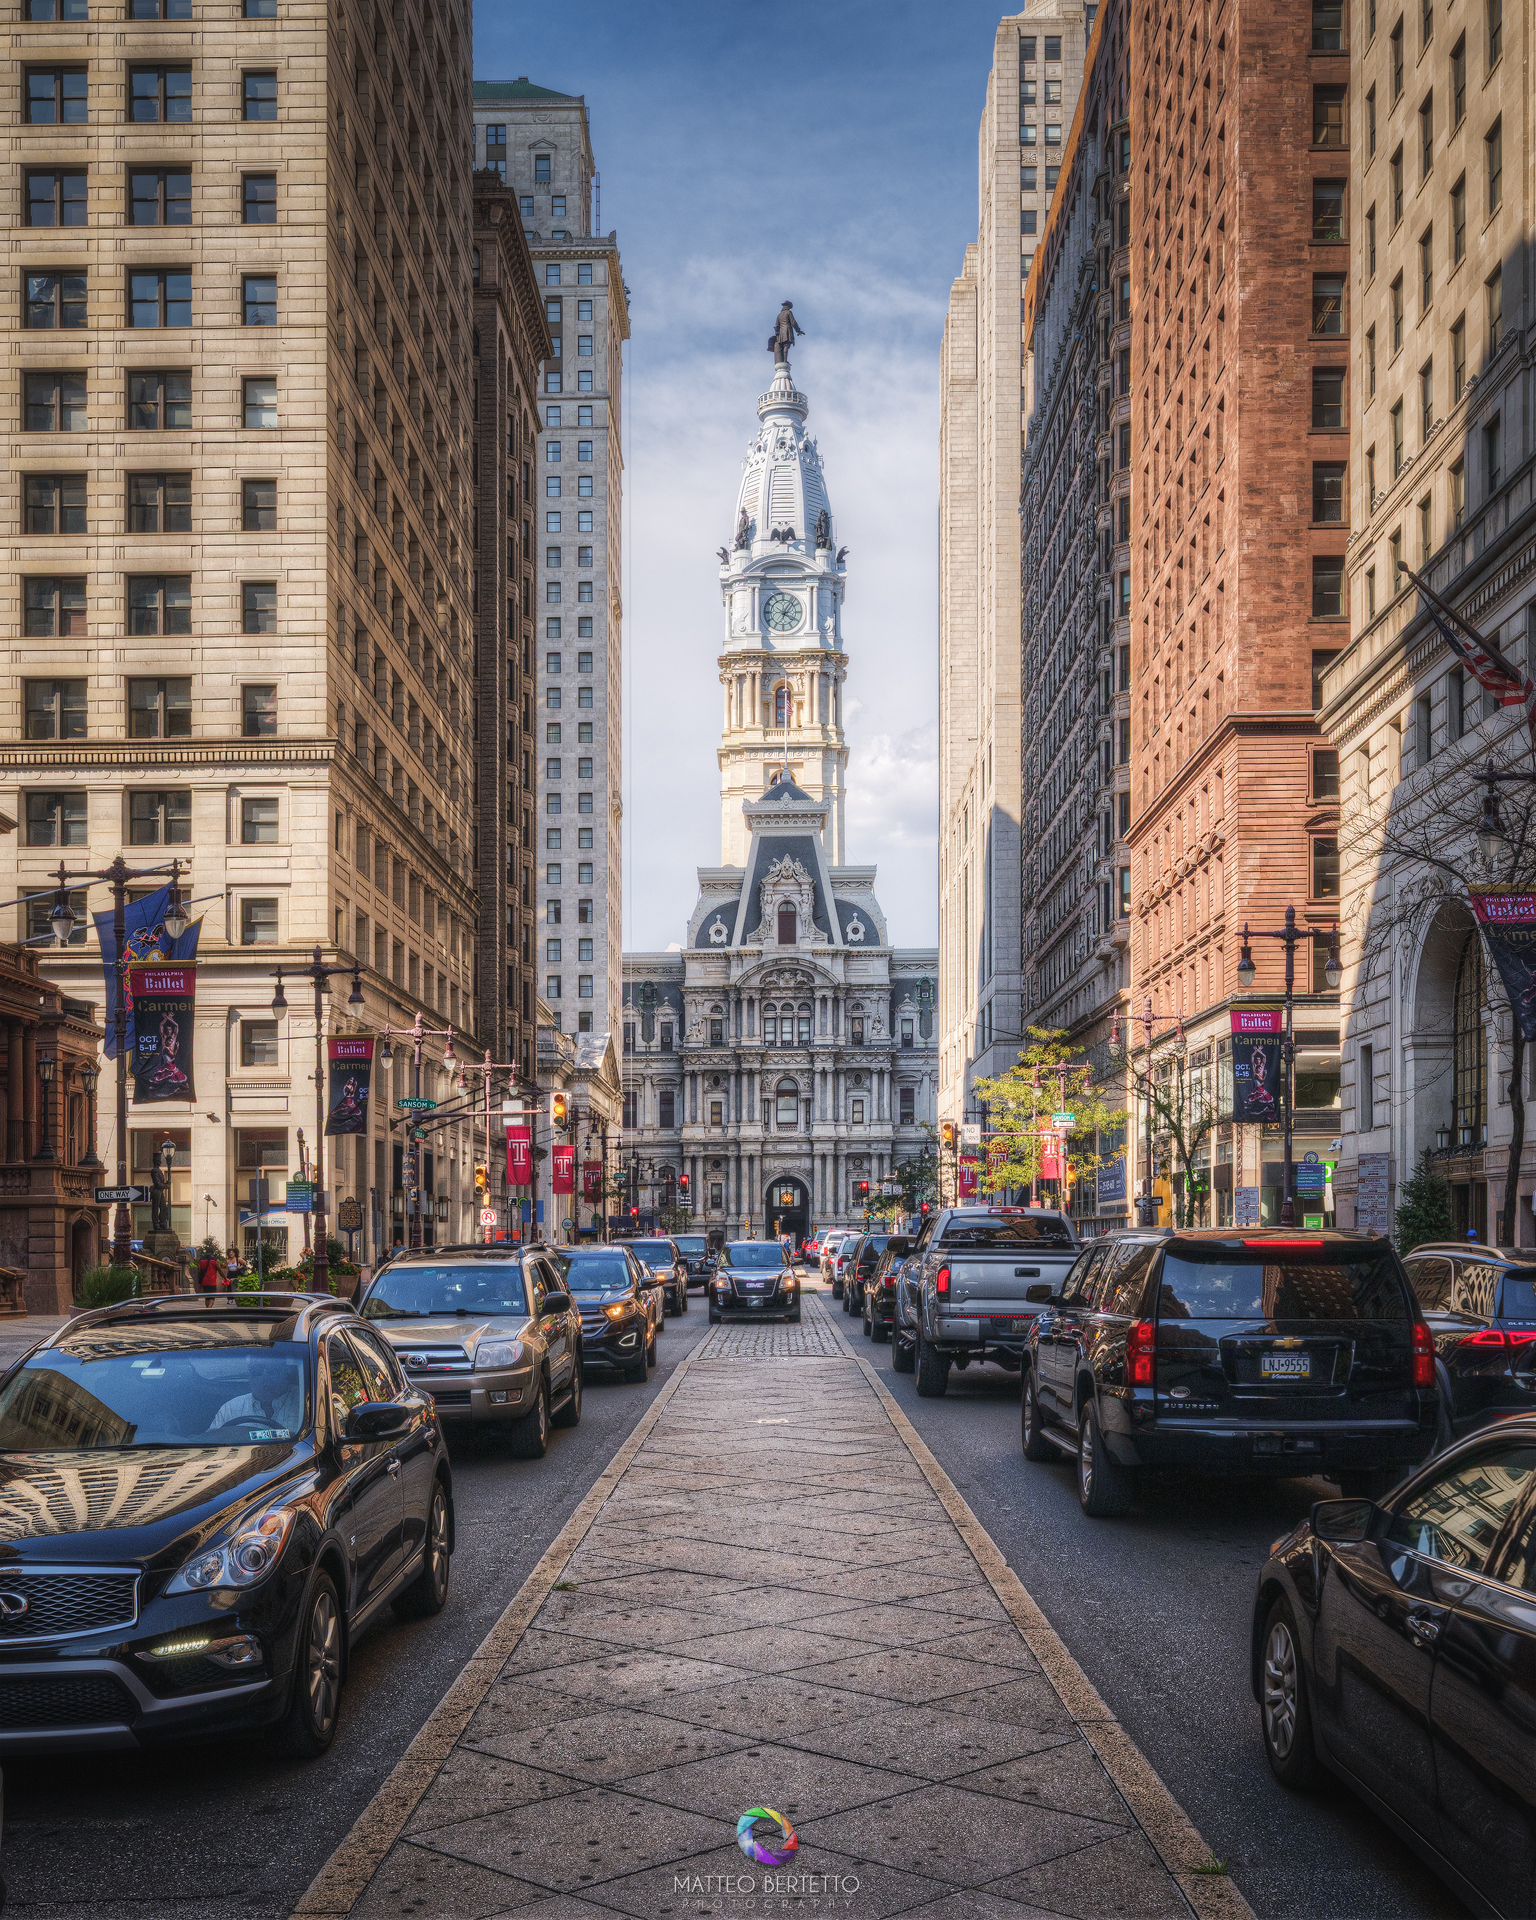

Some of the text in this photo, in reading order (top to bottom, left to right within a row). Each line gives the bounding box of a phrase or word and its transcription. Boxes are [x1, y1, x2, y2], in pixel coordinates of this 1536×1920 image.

[145, 977, 184, 989] Ballet
[138, 1000, 195, 1012] Carmen
[1240, 1018, 1272, 1027] Ballet
[139, 1035, 158, 1043] OCT.
[1234, 1035, 1280, 1046] Carmen
[337, 1045, 366, 1054] Ballet
[1235, 1063, 1251, 1071] OCT.
[398, 1100, 428, 1108] SANSOM
[966, 1126, 976, 1134] NO
[508, 1139, 530, 1166] T
[554, 1155, 573, 1178] T
[99, 1190, 130, 1199] ONE WAY
[1163, 1402, 1220, 1410] SUBURBAN
